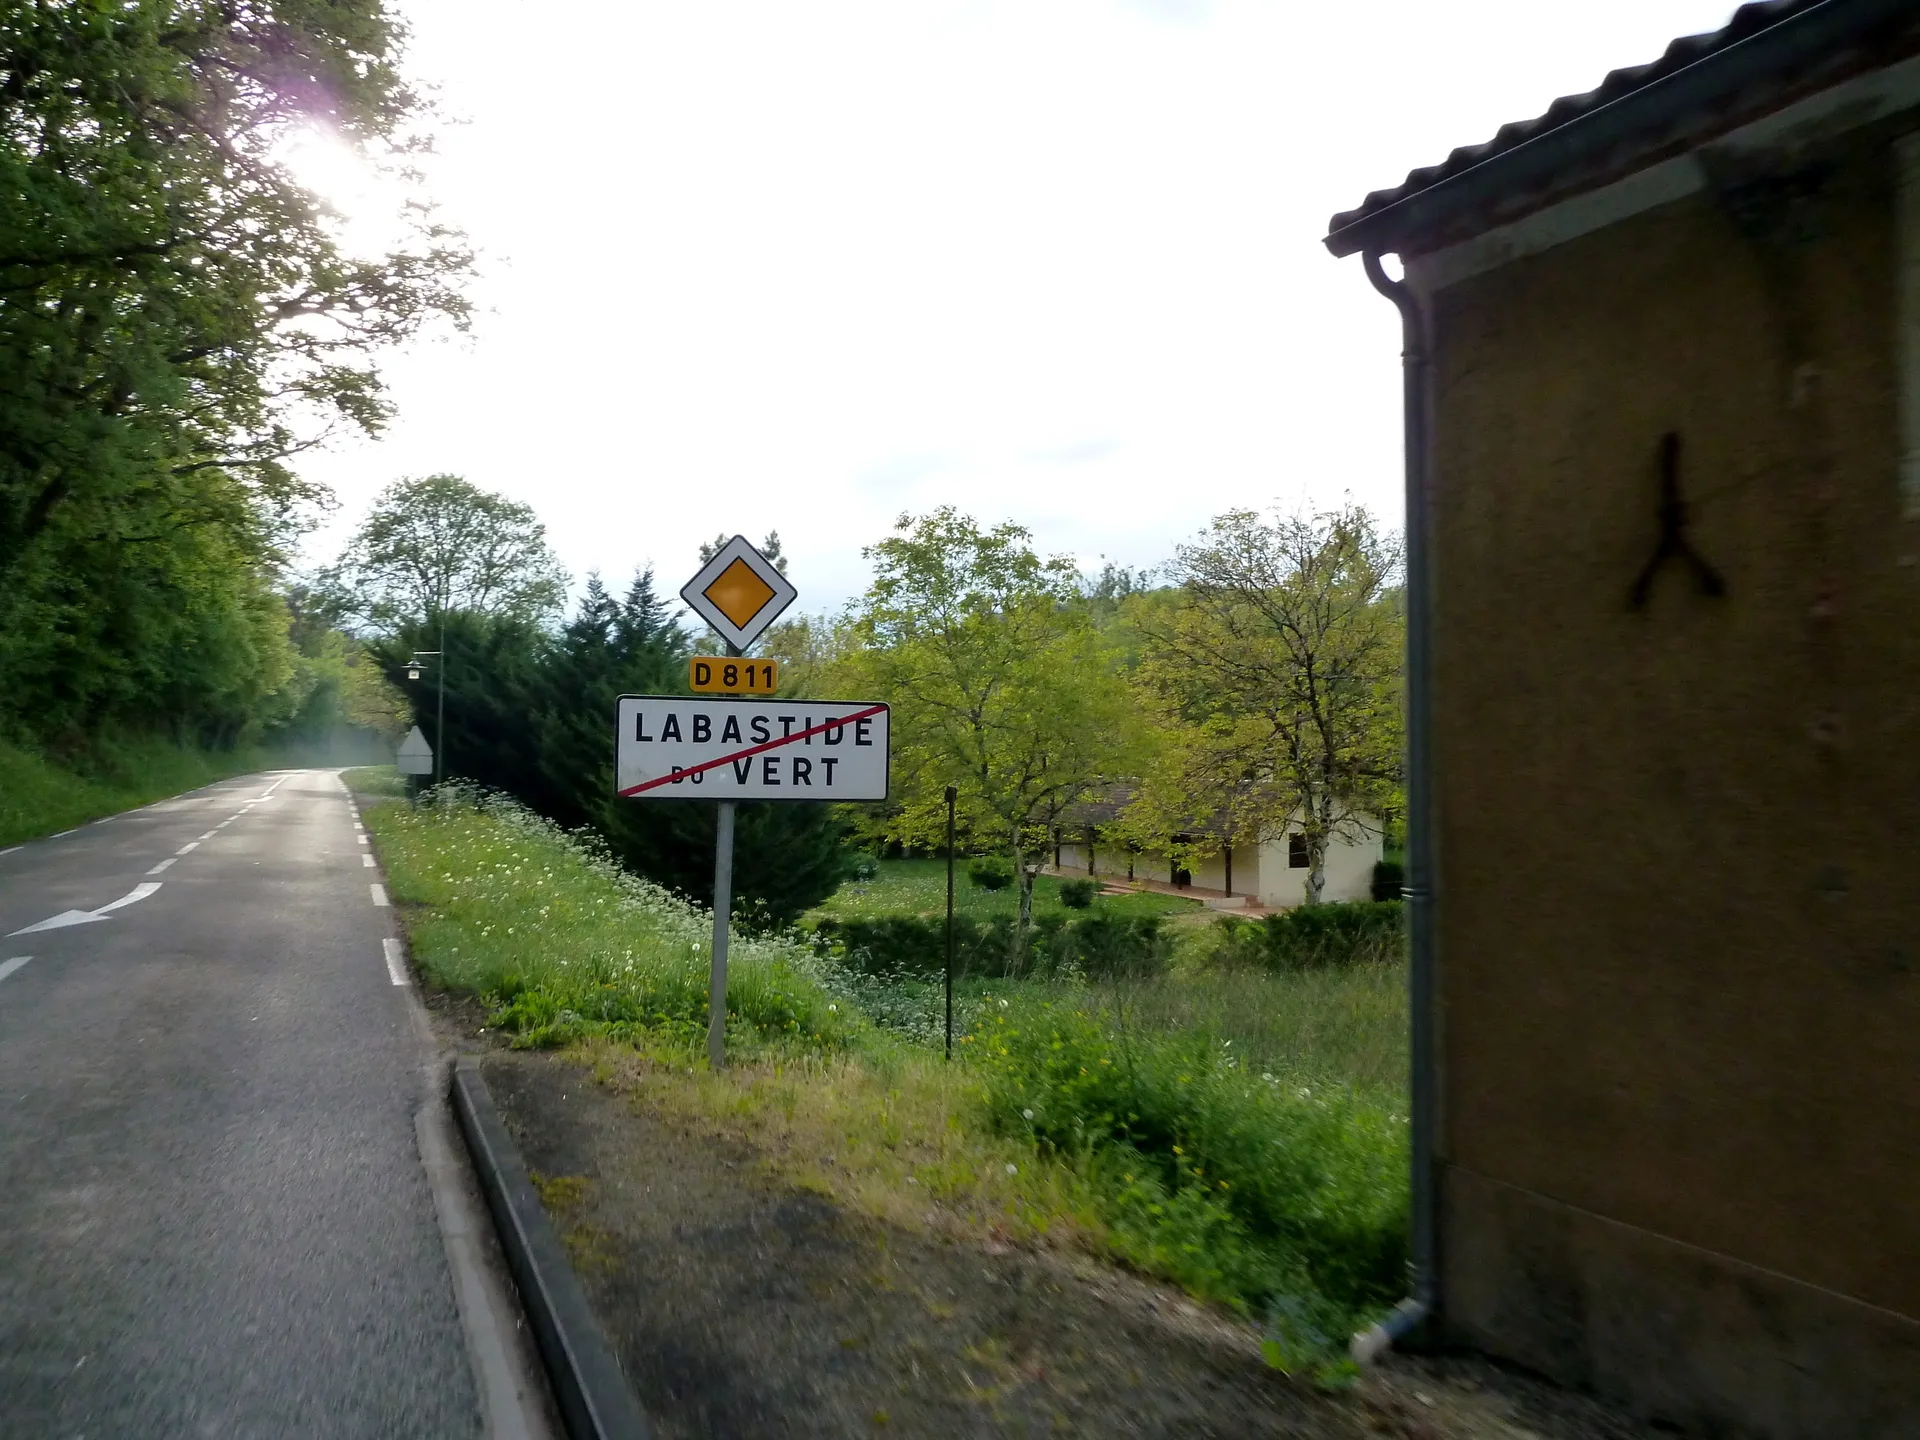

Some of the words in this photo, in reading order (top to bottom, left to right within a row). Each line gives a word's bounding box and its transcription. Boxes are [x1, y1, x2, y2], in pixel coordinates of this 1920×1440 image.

[695, 663, 711, 686] D
[723, 664, 772, 688] 811
[636, 712, 873, 746] LABASTIDE
[671, 765, 704, 785] DU
[732, 756, 839, 786] VERT
